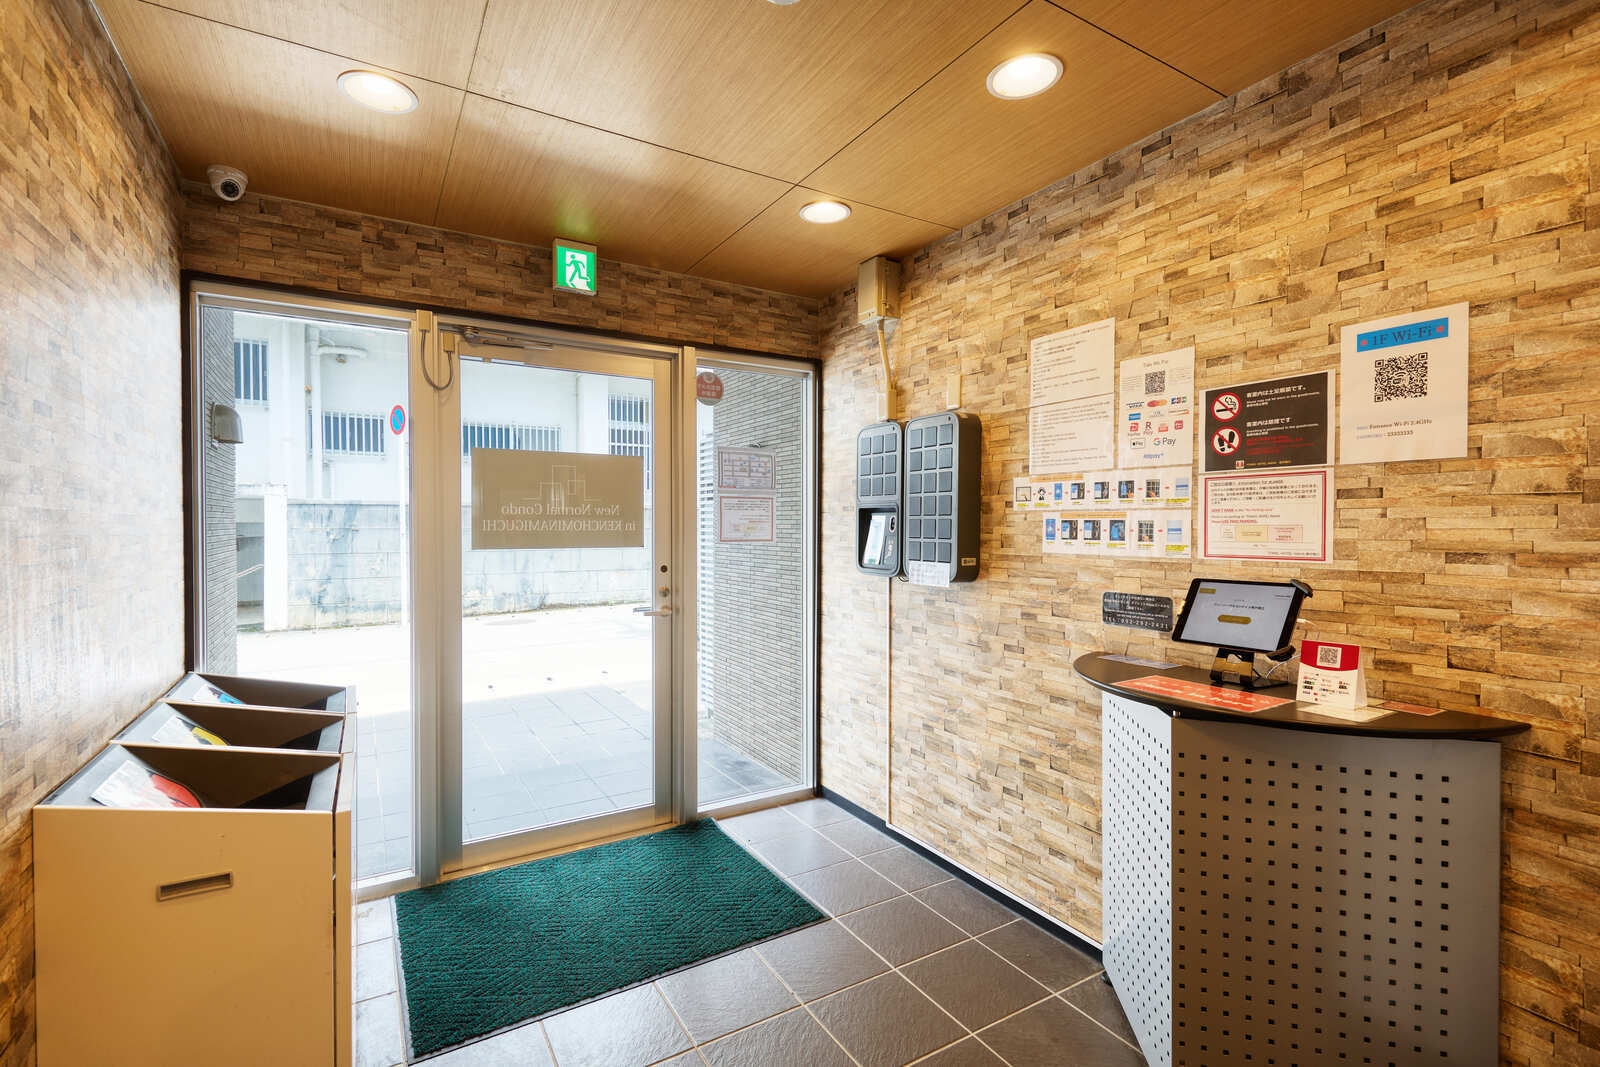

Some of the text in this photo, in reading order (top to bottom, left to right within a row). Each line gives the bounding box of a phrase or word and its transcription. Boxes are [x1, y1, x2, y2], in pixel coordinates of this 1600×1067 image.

[1373, 325, 1432, 346] 1F Wi-Fi
[1162, 437, 1177, 447] Pay
